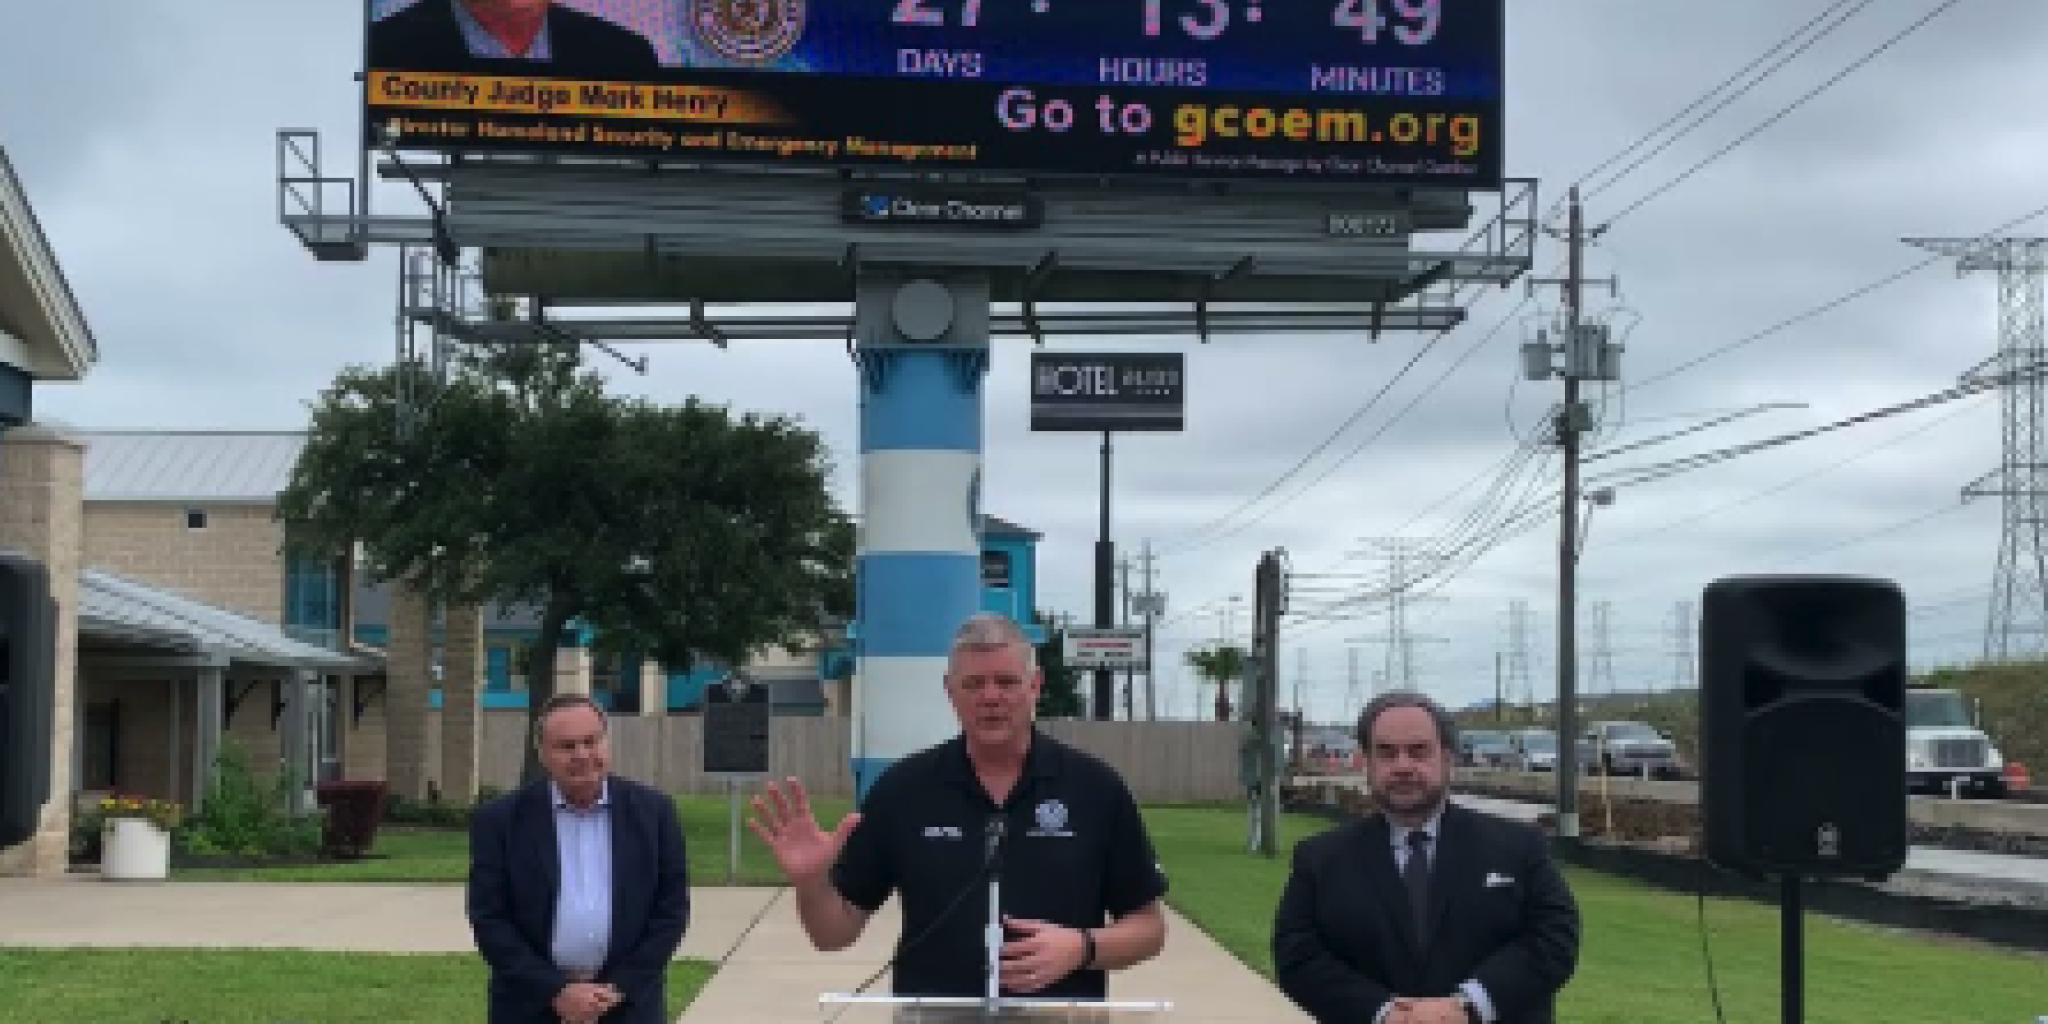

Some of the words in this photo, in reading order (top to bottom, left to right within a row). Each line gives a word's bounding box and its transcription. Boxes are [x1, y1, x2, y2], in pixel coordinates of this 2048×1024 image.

[1333, 0, 1442, 45] 49
[896, 48, 984, 78] DAYS
[1099, 57, 1207, 86] HOURS
[1310, 64, 1445, 95] MINUTES
[381, 75, 479, 105] County
[488, 80, 571, 109] Judge
[579, 84, 645, 110] Mark
[652, 86, 728, 118] Henry
[387, 116, 469, 138] irector
[477, 121, 586, 142] Homeland
[592, 121, 673, 150] Security
[680, 131, 720, 147] and
[726, 131, 839, 160] Emergency
[845, 136, 977, 163] Management
[994, 87, 1073, 132] Go
[1095, 94, 1152, 134] to
[1173, 103, 1481, 156] gcoem.org
[1035, 363, 1119, 395] HOTEL
